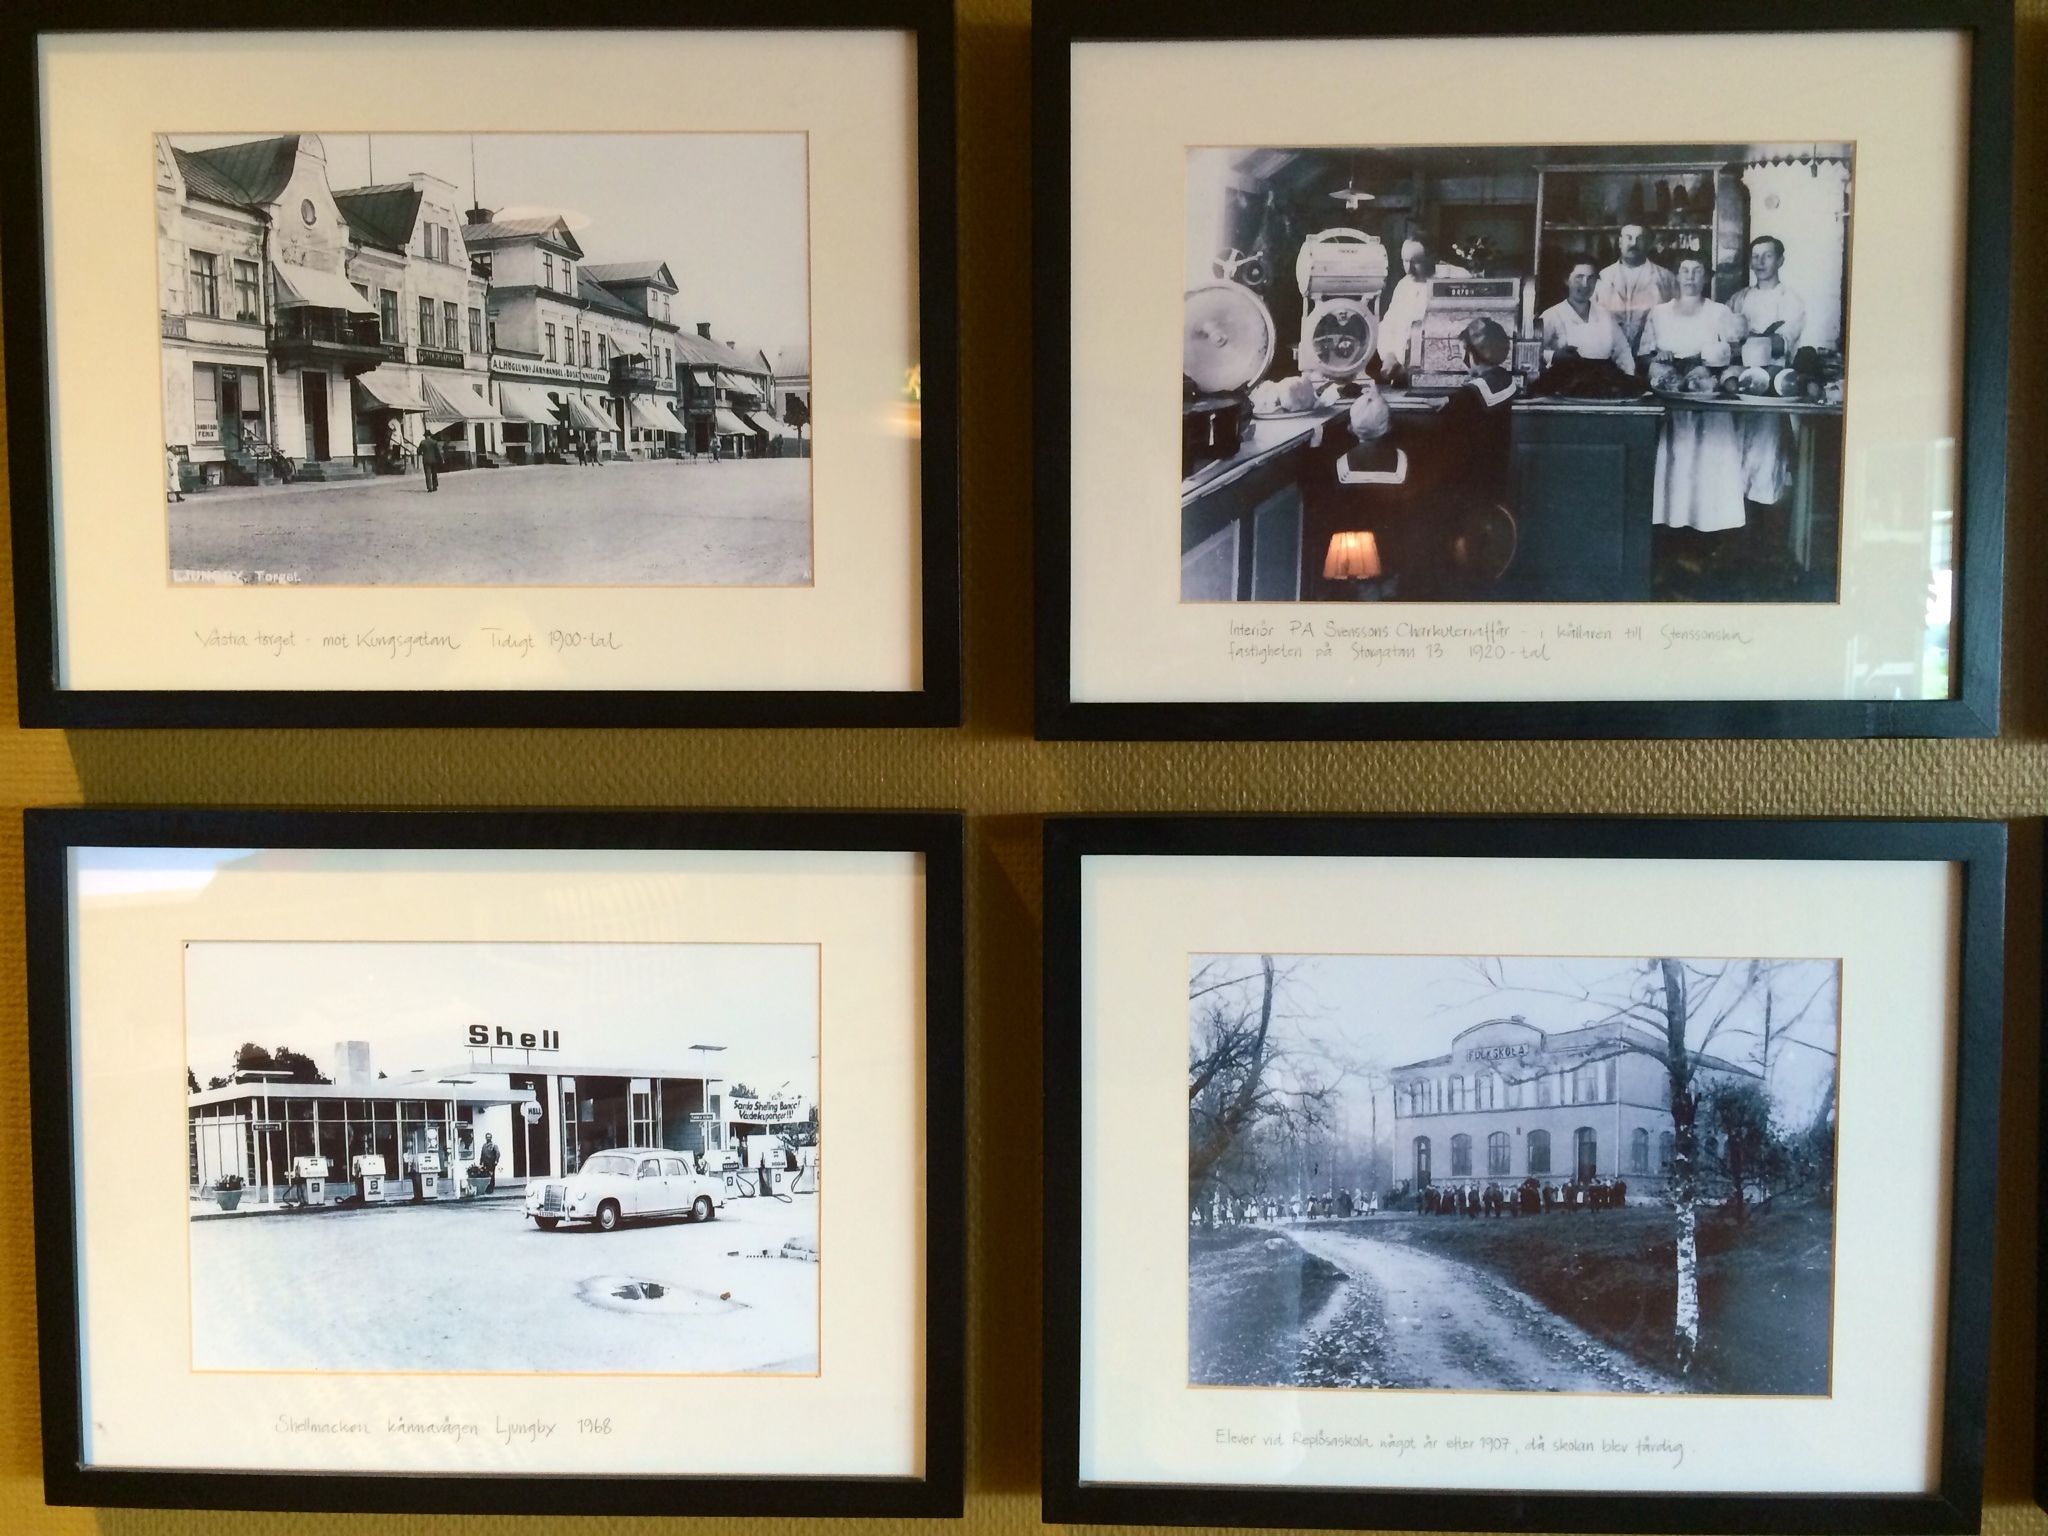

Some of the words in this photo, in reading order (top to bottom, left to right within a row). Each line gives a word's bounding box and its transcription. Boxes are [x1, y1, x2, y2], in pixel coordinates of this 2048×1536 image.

[323, 633, 350, 648] mot
[480, 627, 536, 658] Tidigt
[548, 629, 624, 653] 1900-tal
[1625, 624, 1642, 640] till
[1316, 641, 1333, 661] på
[1425, 642, 1444, 658] 13
[468, 1024, 560, 1050] Shell
[496, 1415, 557, 1445] Ljungby
[577, 1416, 613, 1435] 1968
[1216, 1428, 1256, 1444] Elever
[1263, 1432, 1285, 1446] vid
